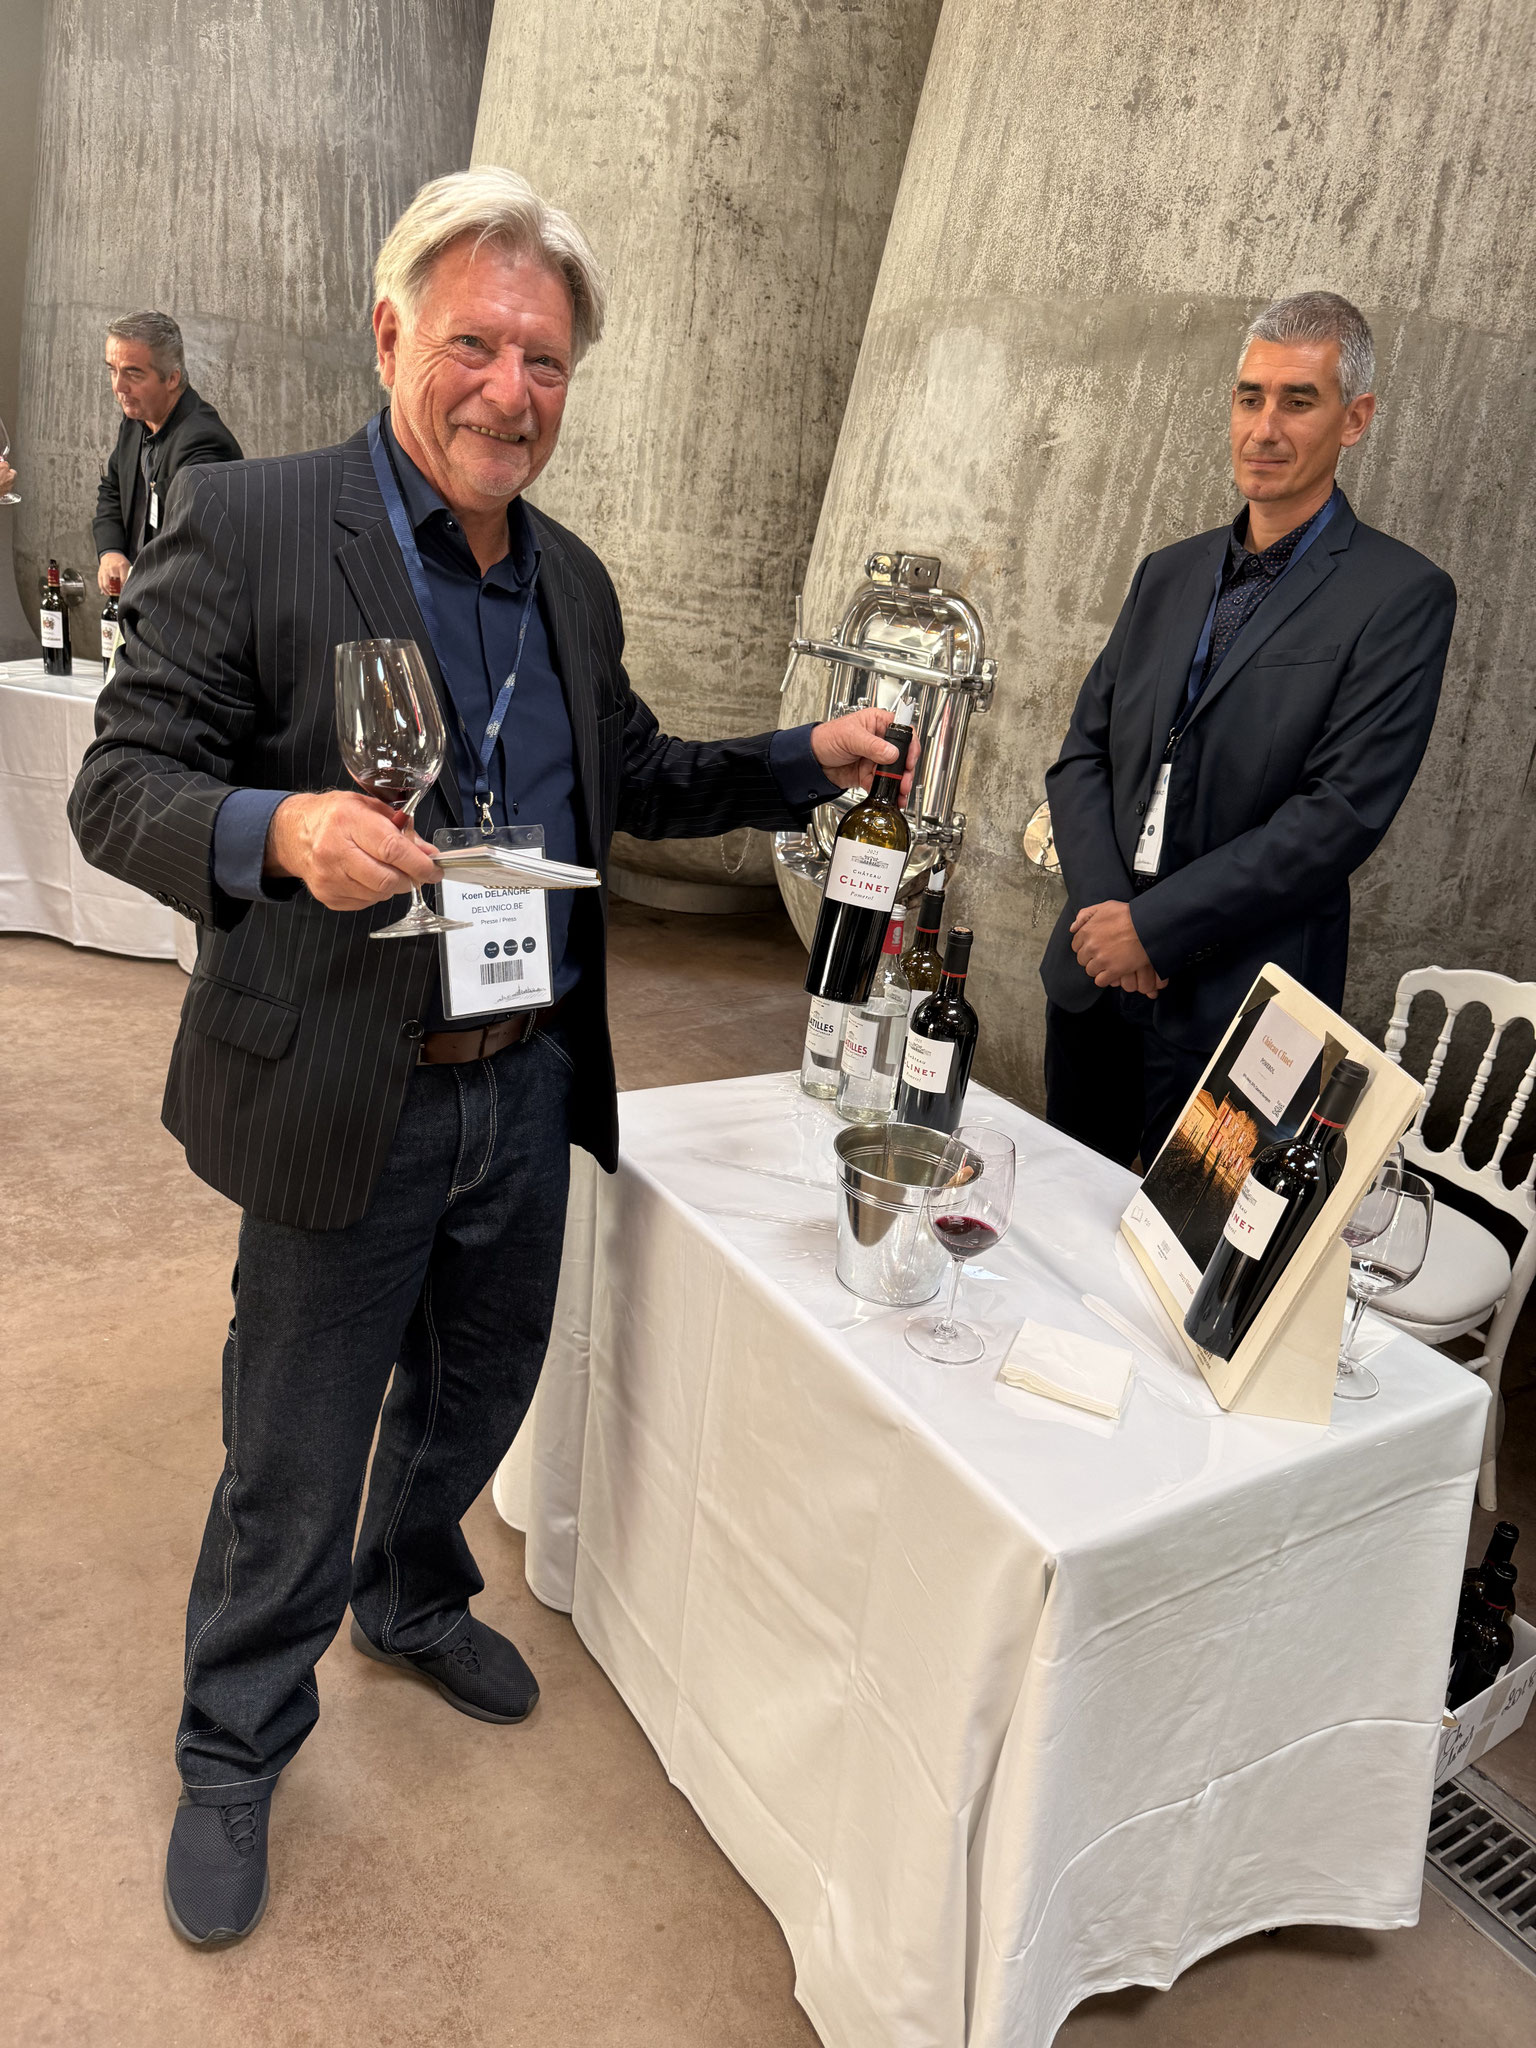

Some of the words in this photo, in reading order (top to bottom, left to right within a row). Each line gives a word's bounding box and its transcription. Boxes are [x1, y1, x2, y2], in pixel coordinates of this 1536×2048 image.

[839, 875, 890, 894] CLINET
[461, 891, 483, 900] Koen
[485, 888, 531, 899] DELANGHE
[850, 891, 875, 901] Pomerol
[480, 917, 498, 925] Presse
[809, 1017, 834, 1033] ATILLES
[904, 1060, 937, 1078] LINET
[1231, 1210, 1255, 1233] INET
